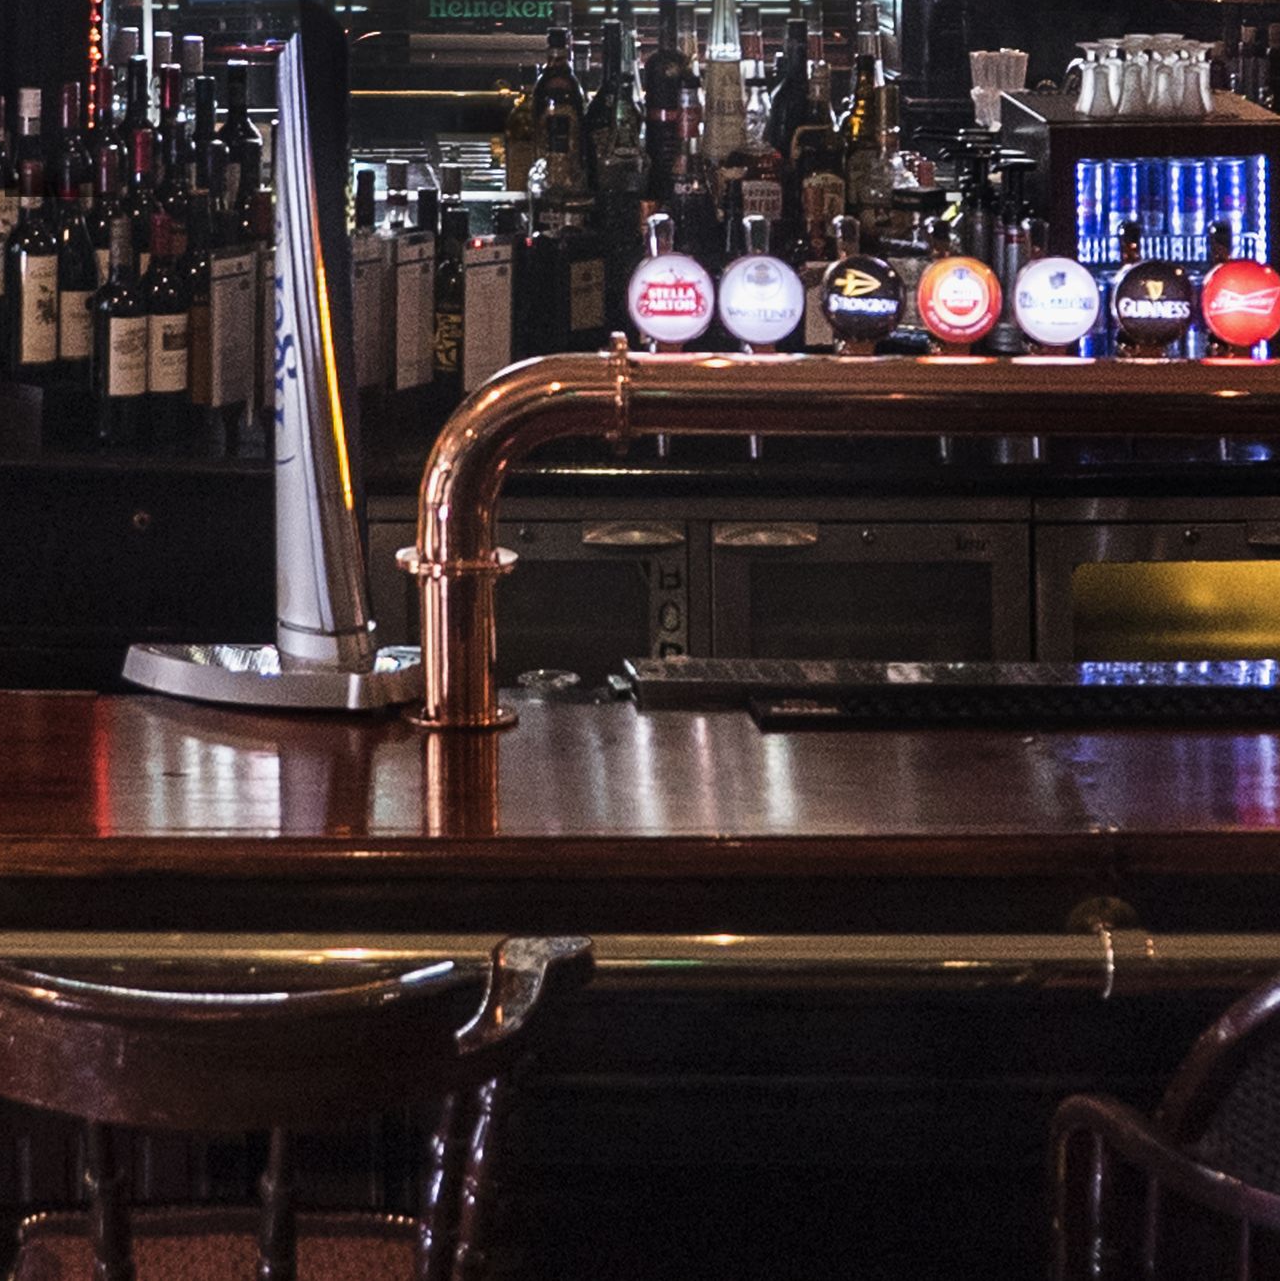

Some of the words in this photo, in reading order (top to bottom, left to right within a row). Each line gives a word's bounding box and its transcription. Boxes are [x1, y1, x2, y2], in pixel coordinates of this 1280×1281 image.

[648, 287, 696, 300] STELLA
[648, 299, 697, 312] ARTOIS
[829, 293, 898, 315] STRONGBOW
[1119, 299, 1190, 318] GUINNESS
